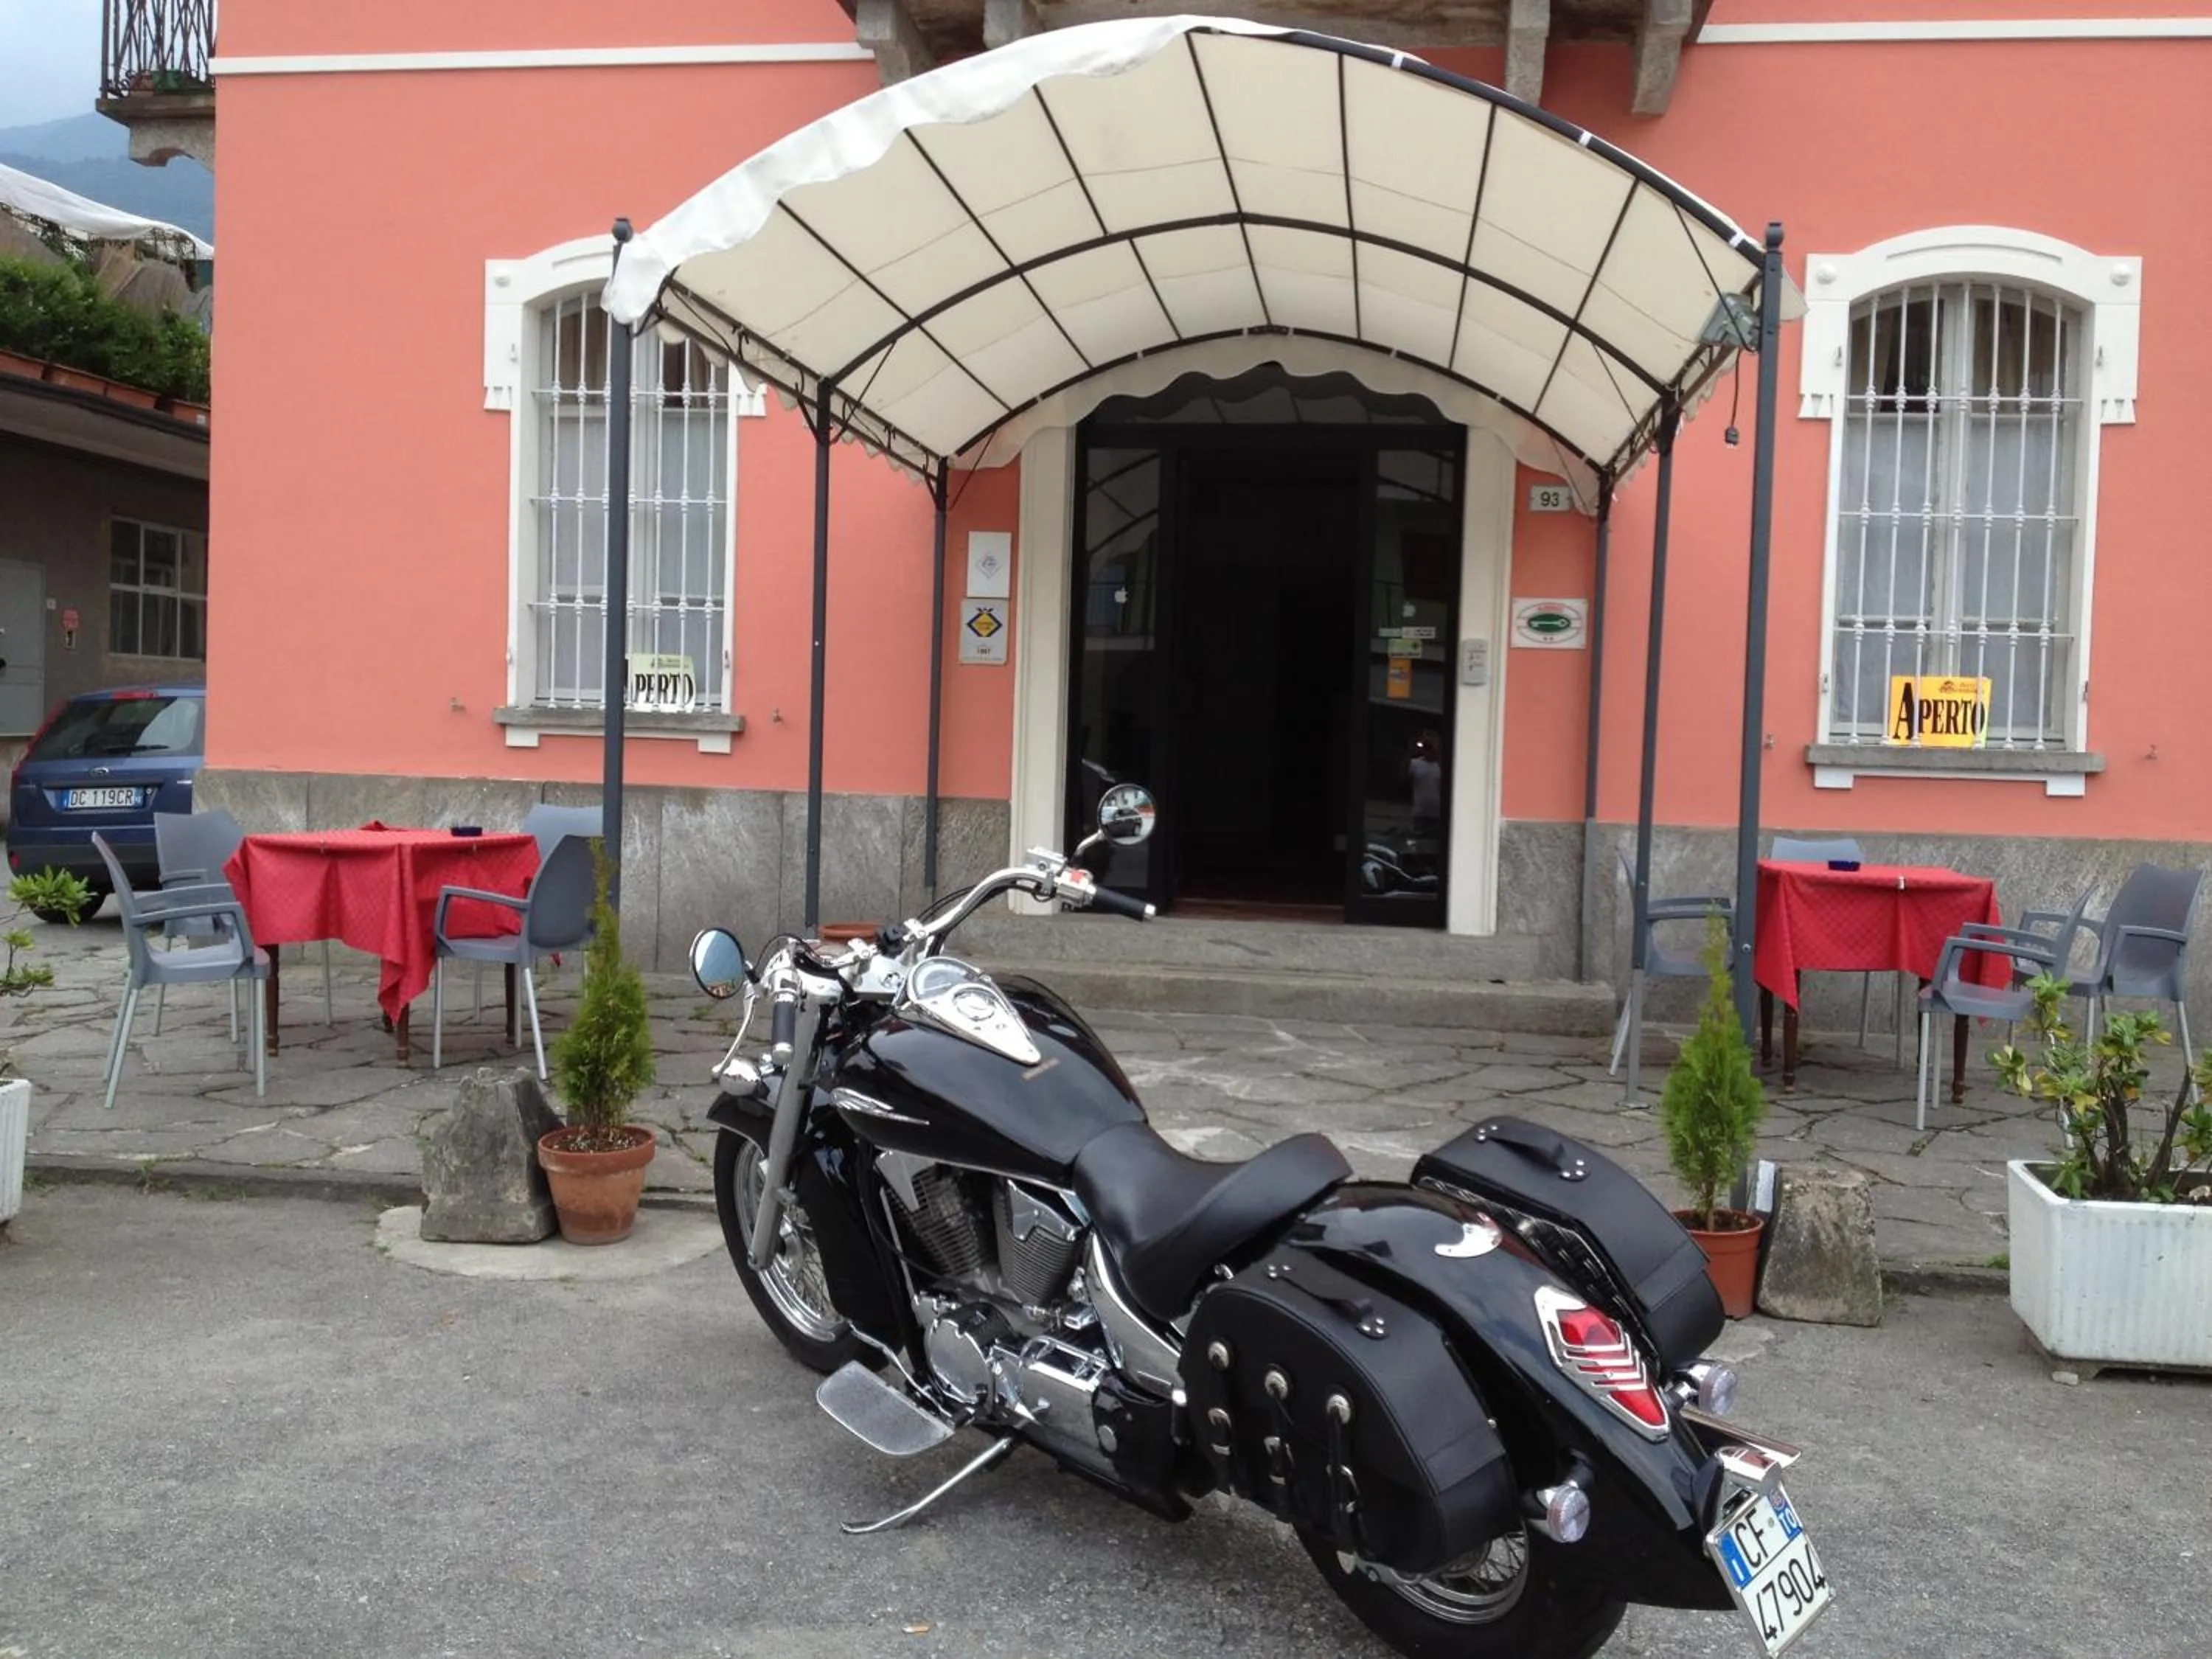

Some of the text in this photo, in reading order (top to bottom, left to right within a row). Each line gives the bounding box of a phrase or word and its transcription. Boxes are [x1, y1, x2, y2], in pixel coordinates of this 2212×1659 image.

[1540, 491, 1559, 507] 93
[625, 658, 694, 705] PERTO
[1892, 682, 1986, 740] APERTO
[94, 790, 133, 804] 119CR
[1735, 1508, 1769, 1568] CF
[1779, 1509, 1798, 1535] TO
[1756, 1543, 1826, 1641] 47904
